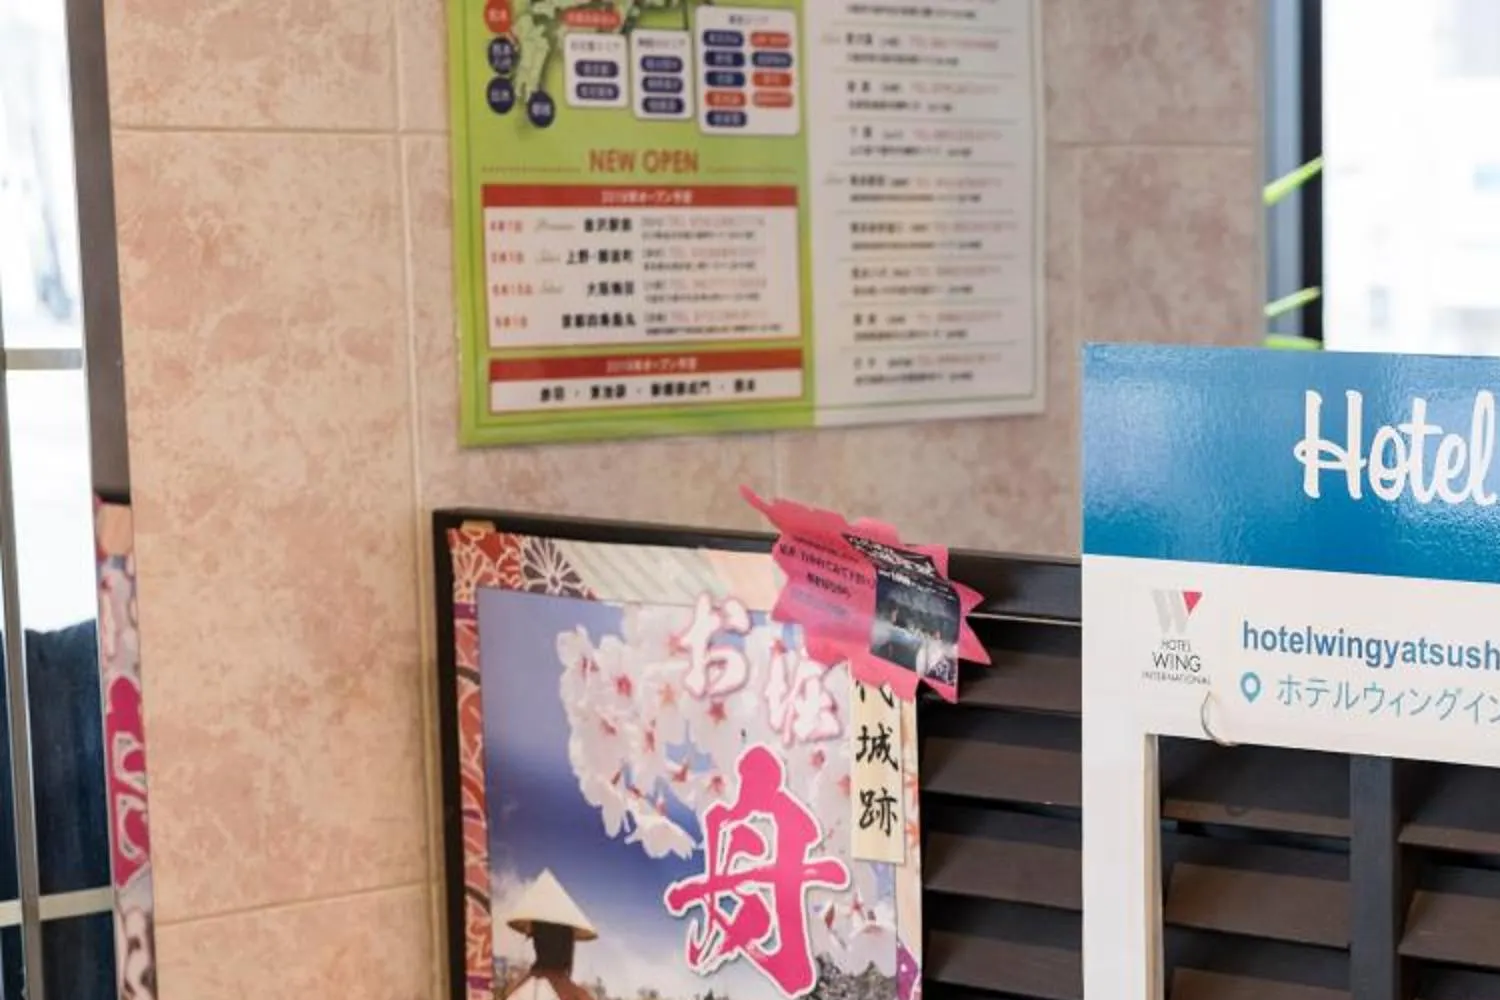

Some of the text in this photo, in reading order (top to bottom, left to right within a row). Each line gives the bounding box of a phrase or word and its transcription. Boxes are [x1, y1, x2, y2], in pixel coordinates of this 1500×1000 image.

[589, 148, 699, 173] NEW OPEN
[1292, 389, 1499, 506] Hotel
[1161, 640, 1191, 652] HOTEL
[1151, 651, 1201, 673] WING
